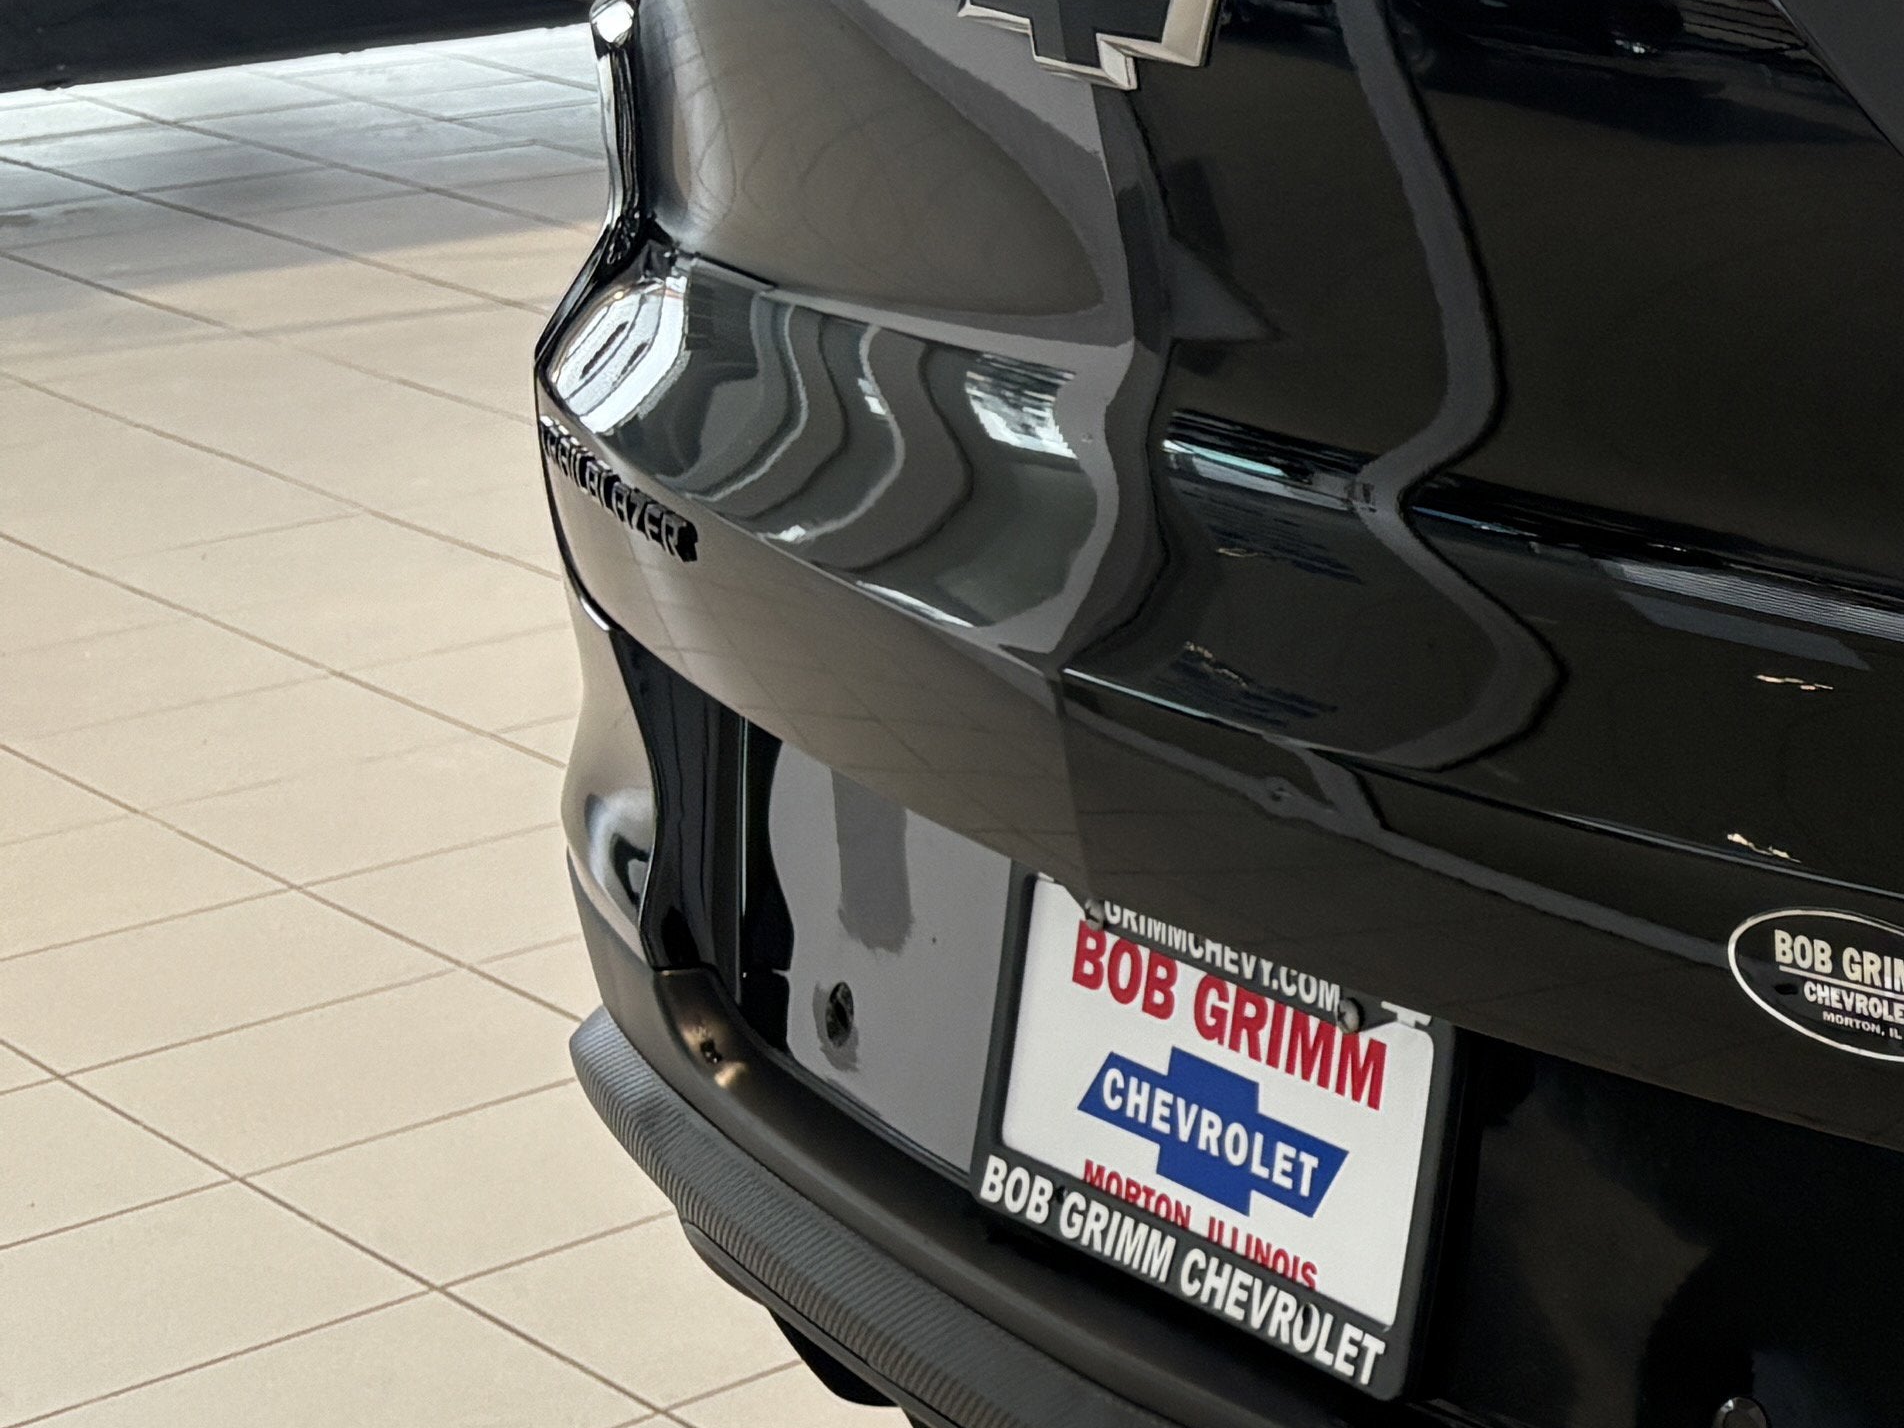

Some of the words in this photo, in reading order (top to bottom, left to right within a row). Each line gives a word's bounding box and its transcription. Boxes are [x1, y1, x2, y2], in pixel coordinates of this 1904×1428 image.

[1072, 919, 1178, 1020] BOB
[1193, 974, 1387, 1111] GRIMM
[1774, 928, 1833, 974] BOB
[1889, 1026, 1903, 1041] IL
[1102, 1067, 1320, 1198] CHEVROLET
[979, 1154, 1053, 1225] BOB
[1058, 1191, 1177, 1284] GRIMM
[1179, 1247, 1387, 1387] CHEVROLET
[1084, 1159, 1191, 1230] MORTON
[1207, 1216, 1319, 1290] ILLINOIS
